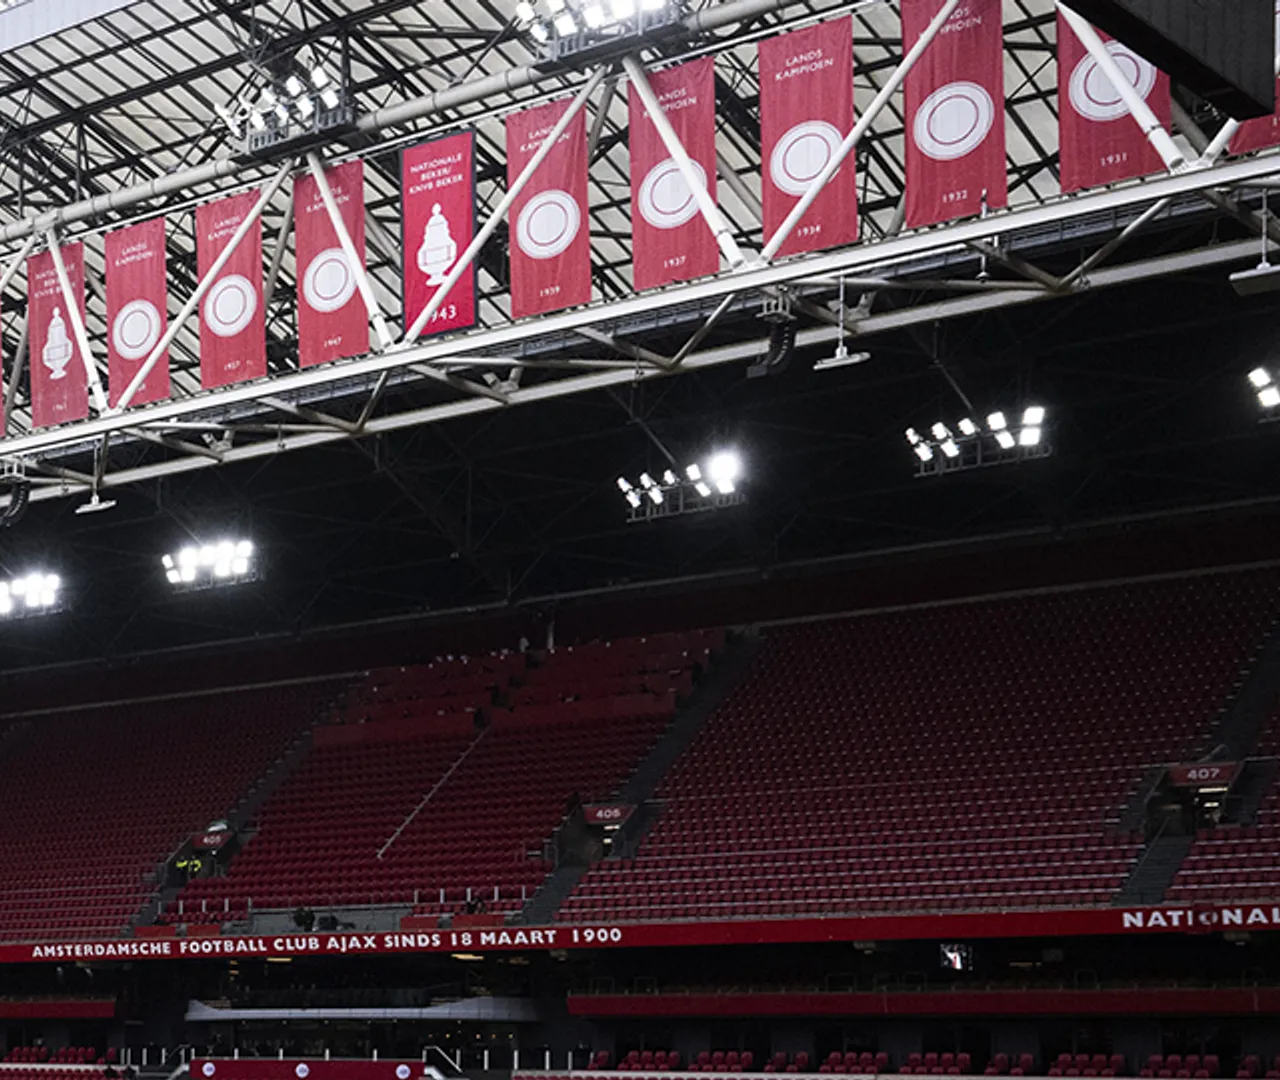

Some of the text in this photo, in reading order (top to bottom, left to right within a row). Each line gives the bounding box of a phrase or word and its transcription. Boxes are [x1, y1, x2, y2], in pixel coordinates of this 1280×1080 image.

[785, 48, 823, 67] LANDS
[775, 57, 834, 80] KAMPIOEN
[410, 152, 463, 174] NATIONALE
[1101, 151, 1128, 166] 1931
[408, 172, 463, 195] KNVB BEKER
[942, 189, 967, 202] 1932
[1186, 767, 1221, 781] 407
[32, 927, 623, 958] AMSTERDAMSCHE FOOTBALL CLUB AJAX SINDS 18 MAART 1900
